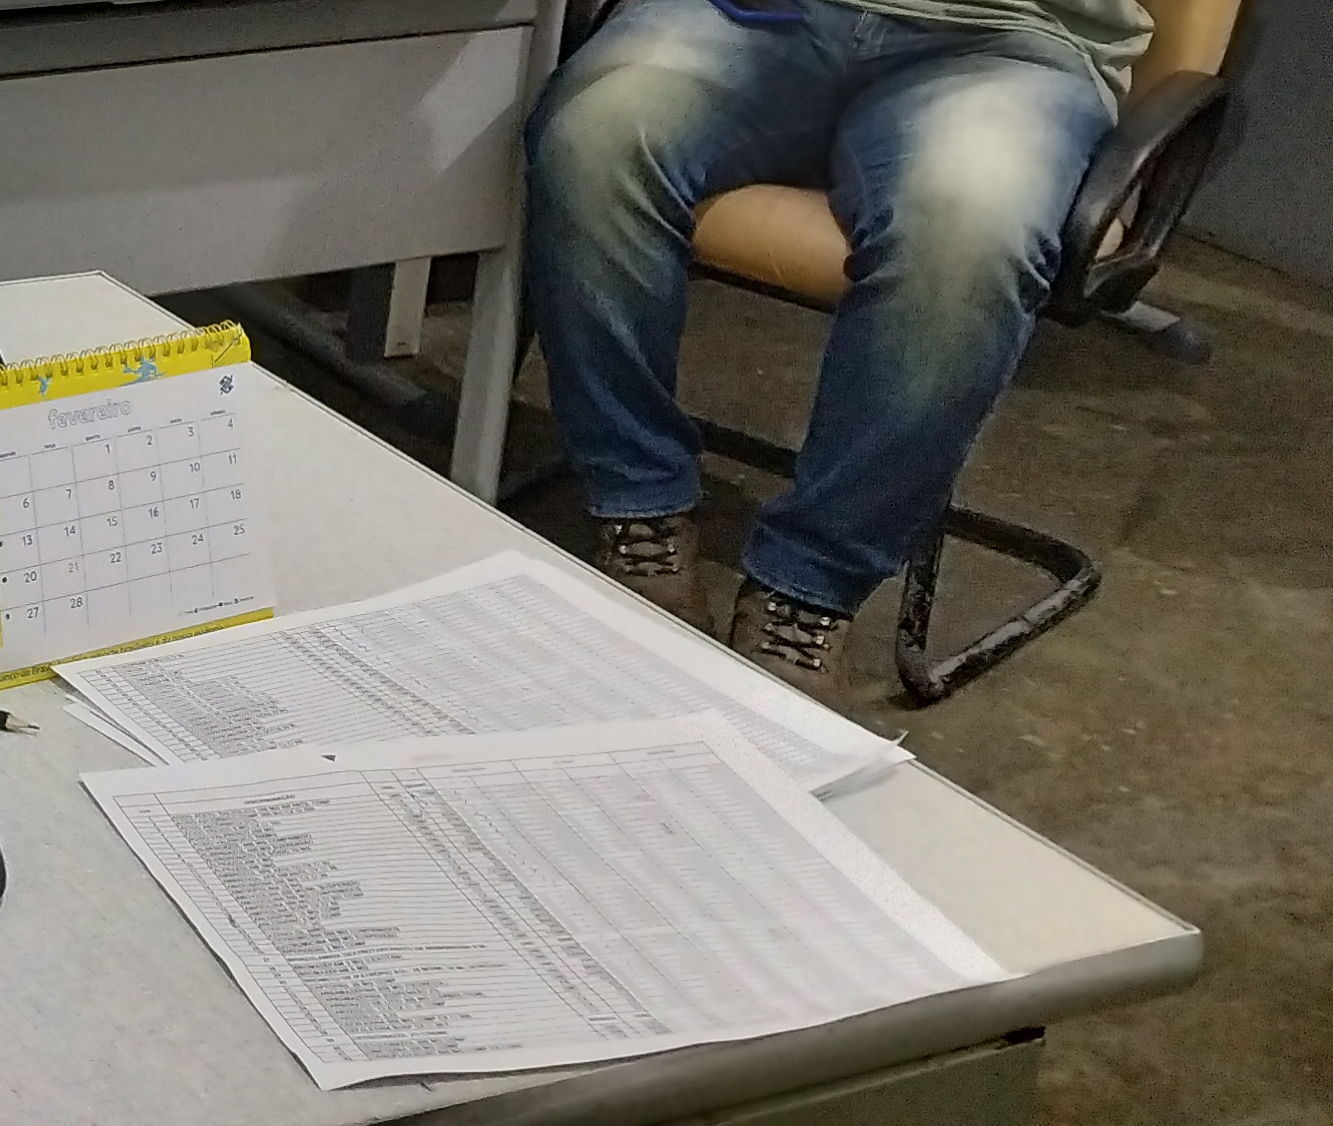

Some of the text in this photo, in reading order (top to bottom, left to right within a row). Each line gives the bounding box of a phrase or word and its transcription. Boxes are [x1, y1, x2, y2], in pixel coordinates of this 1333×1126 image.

[48, 399, 132, 430] fevereiro
[105, 418, 233, 454] 1 2 3 4
[23, 497, 30, 509] 6
[65, 488, 72, 499] 7
[108, 480, 115, 490] 8
[150, 471, 157, 481] 9
[189, 462, 200, 472] 10
[228, 454, 237, 464] 11
[21, 535, 33, 547] 13
[64, 526, 76, 537] 14
[107, 516, 118, 526] 15
[148, 507, 160, 518] 16
[189, 498, 200, 509] 17
[230, 489, 241, 500] 18
[24, 571, 37, 583] 20
[68, 562, 79, 573] 21
[110, 552, 122, 564] 22
[151, 543, 163, 555] 23
[192, 534, 204, 545] 24
[234, 524, 246, 536] 25
[27, 607, 39, 618] 27
[70, 597, 83, 609] 28
